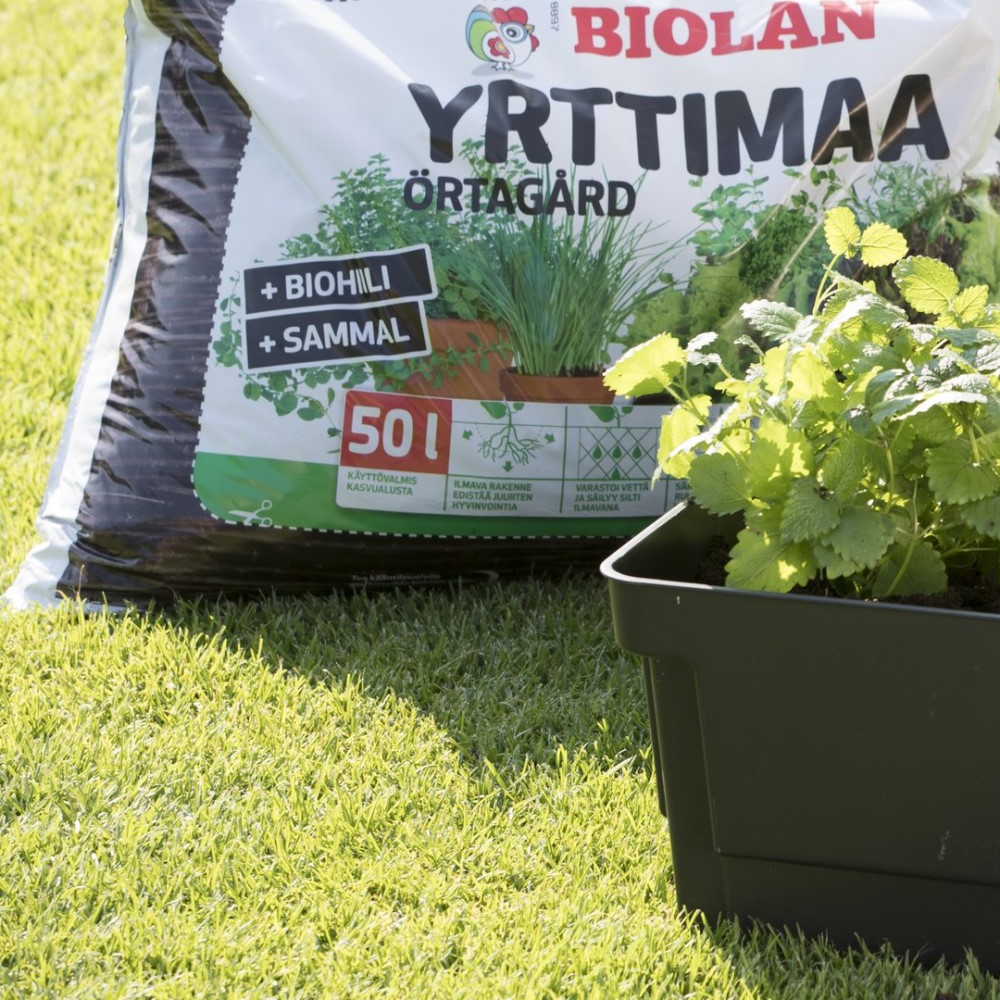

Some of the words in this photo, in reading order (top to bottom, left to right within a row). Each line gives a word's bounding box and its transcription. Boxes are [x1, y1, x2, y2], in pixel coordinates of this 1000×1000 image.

[571, 0, 879, 58] BIOLAN
[408, 73, 951, 177] YRTTIMAA
[403, 168, 637, 218] ÖRTAGÅRD
[283, 317, 411, 353] SAMMAL
[348, 405, 414, 458] 50
[347, 470, 418, 485] KÄYTTÖVALMIS
[346, 482, 413, 496] KASVUALUSTA
[454, 480, 487, 490] ILMAVA
[489, 481, 532, 492] RAKENNE
[575, 483, 619, 492] VARASTOI
[622, 482, 649, 492] VETTÄ
[453, 490, 490, 500] EDISTÄÄ
[492, 492, 533, 502] JUURTEN
[574, 494, 585, 502] JA
[586, 492, 618, 502] SÄILYY
[452, 501, 518, 511] HYVINVOINTIA
[574, 503, 619, 511] ILMAVANA
